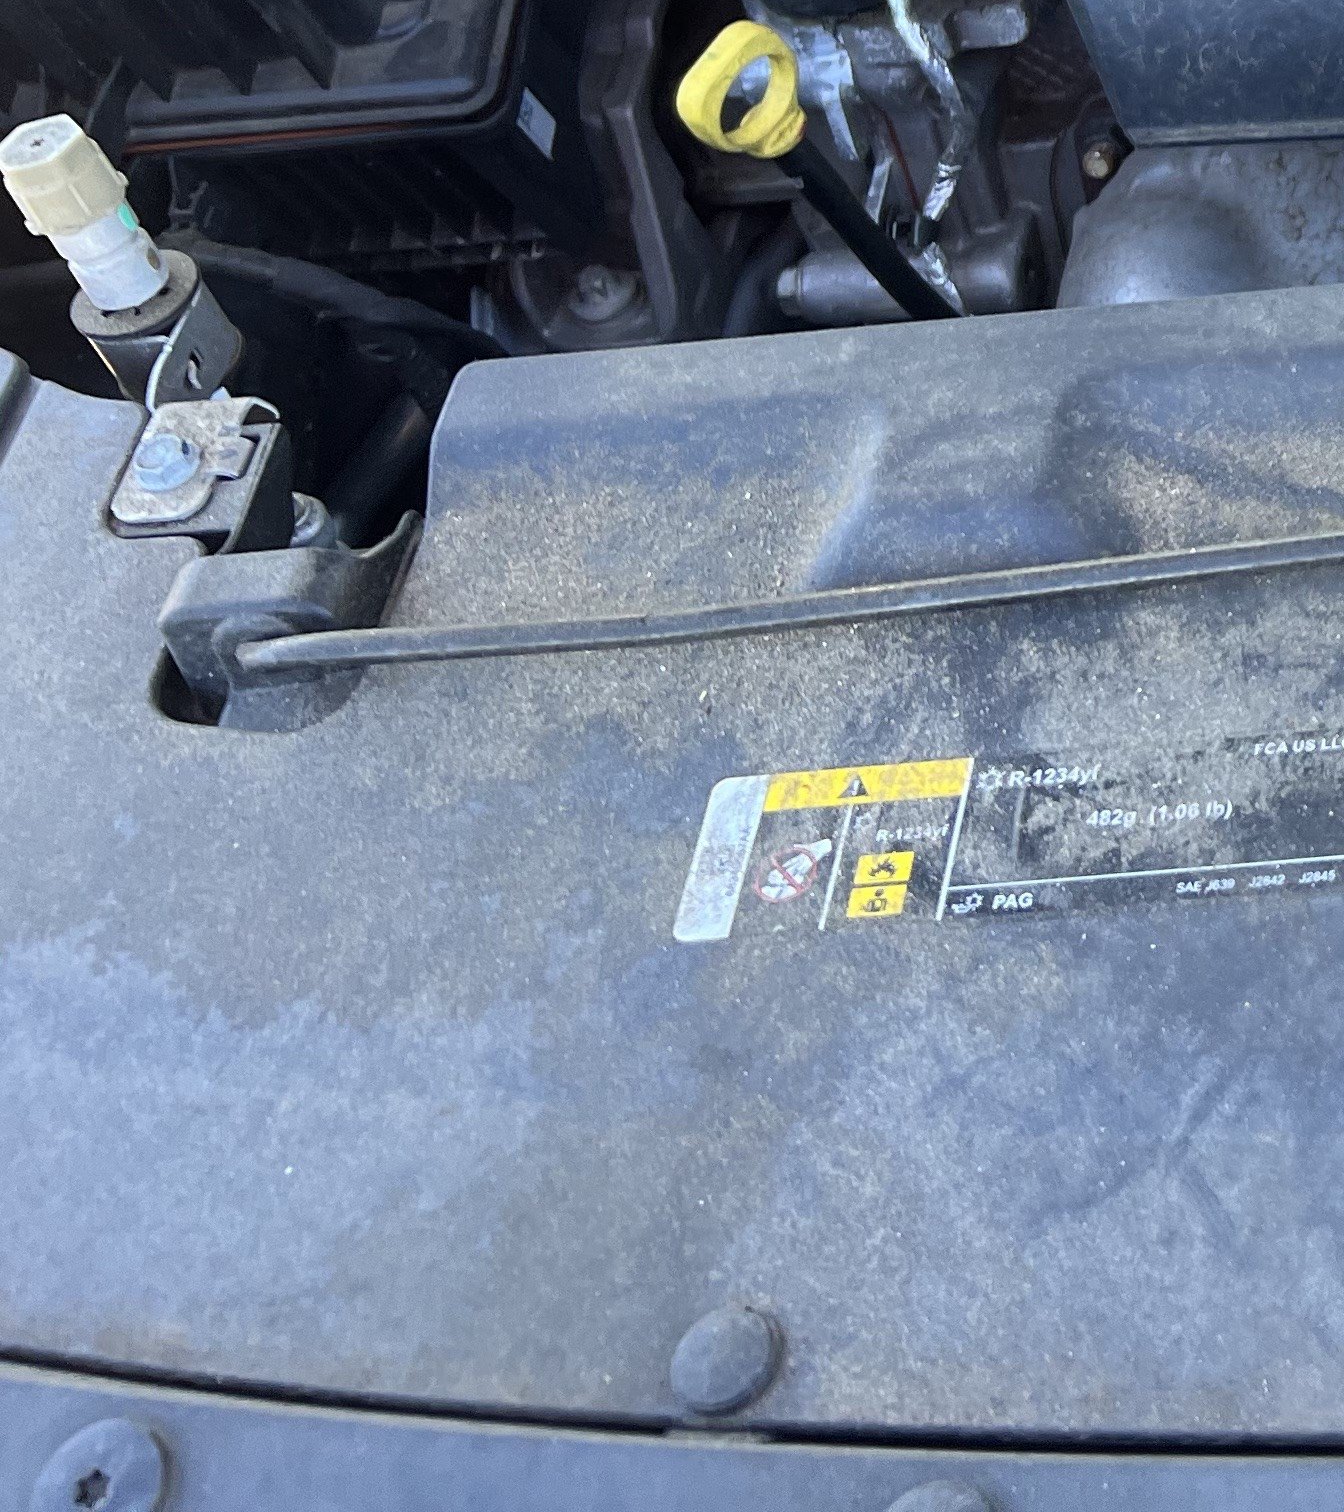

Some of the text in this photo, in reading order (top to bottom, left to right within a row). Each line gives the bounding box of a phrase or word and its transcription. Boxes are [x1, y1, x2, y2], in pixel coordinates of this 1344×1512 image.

[1253, 739, 1289, 756] FCA
[1291, 737, 1317, 753] US
[991, 892, 1035, 911] PAG
